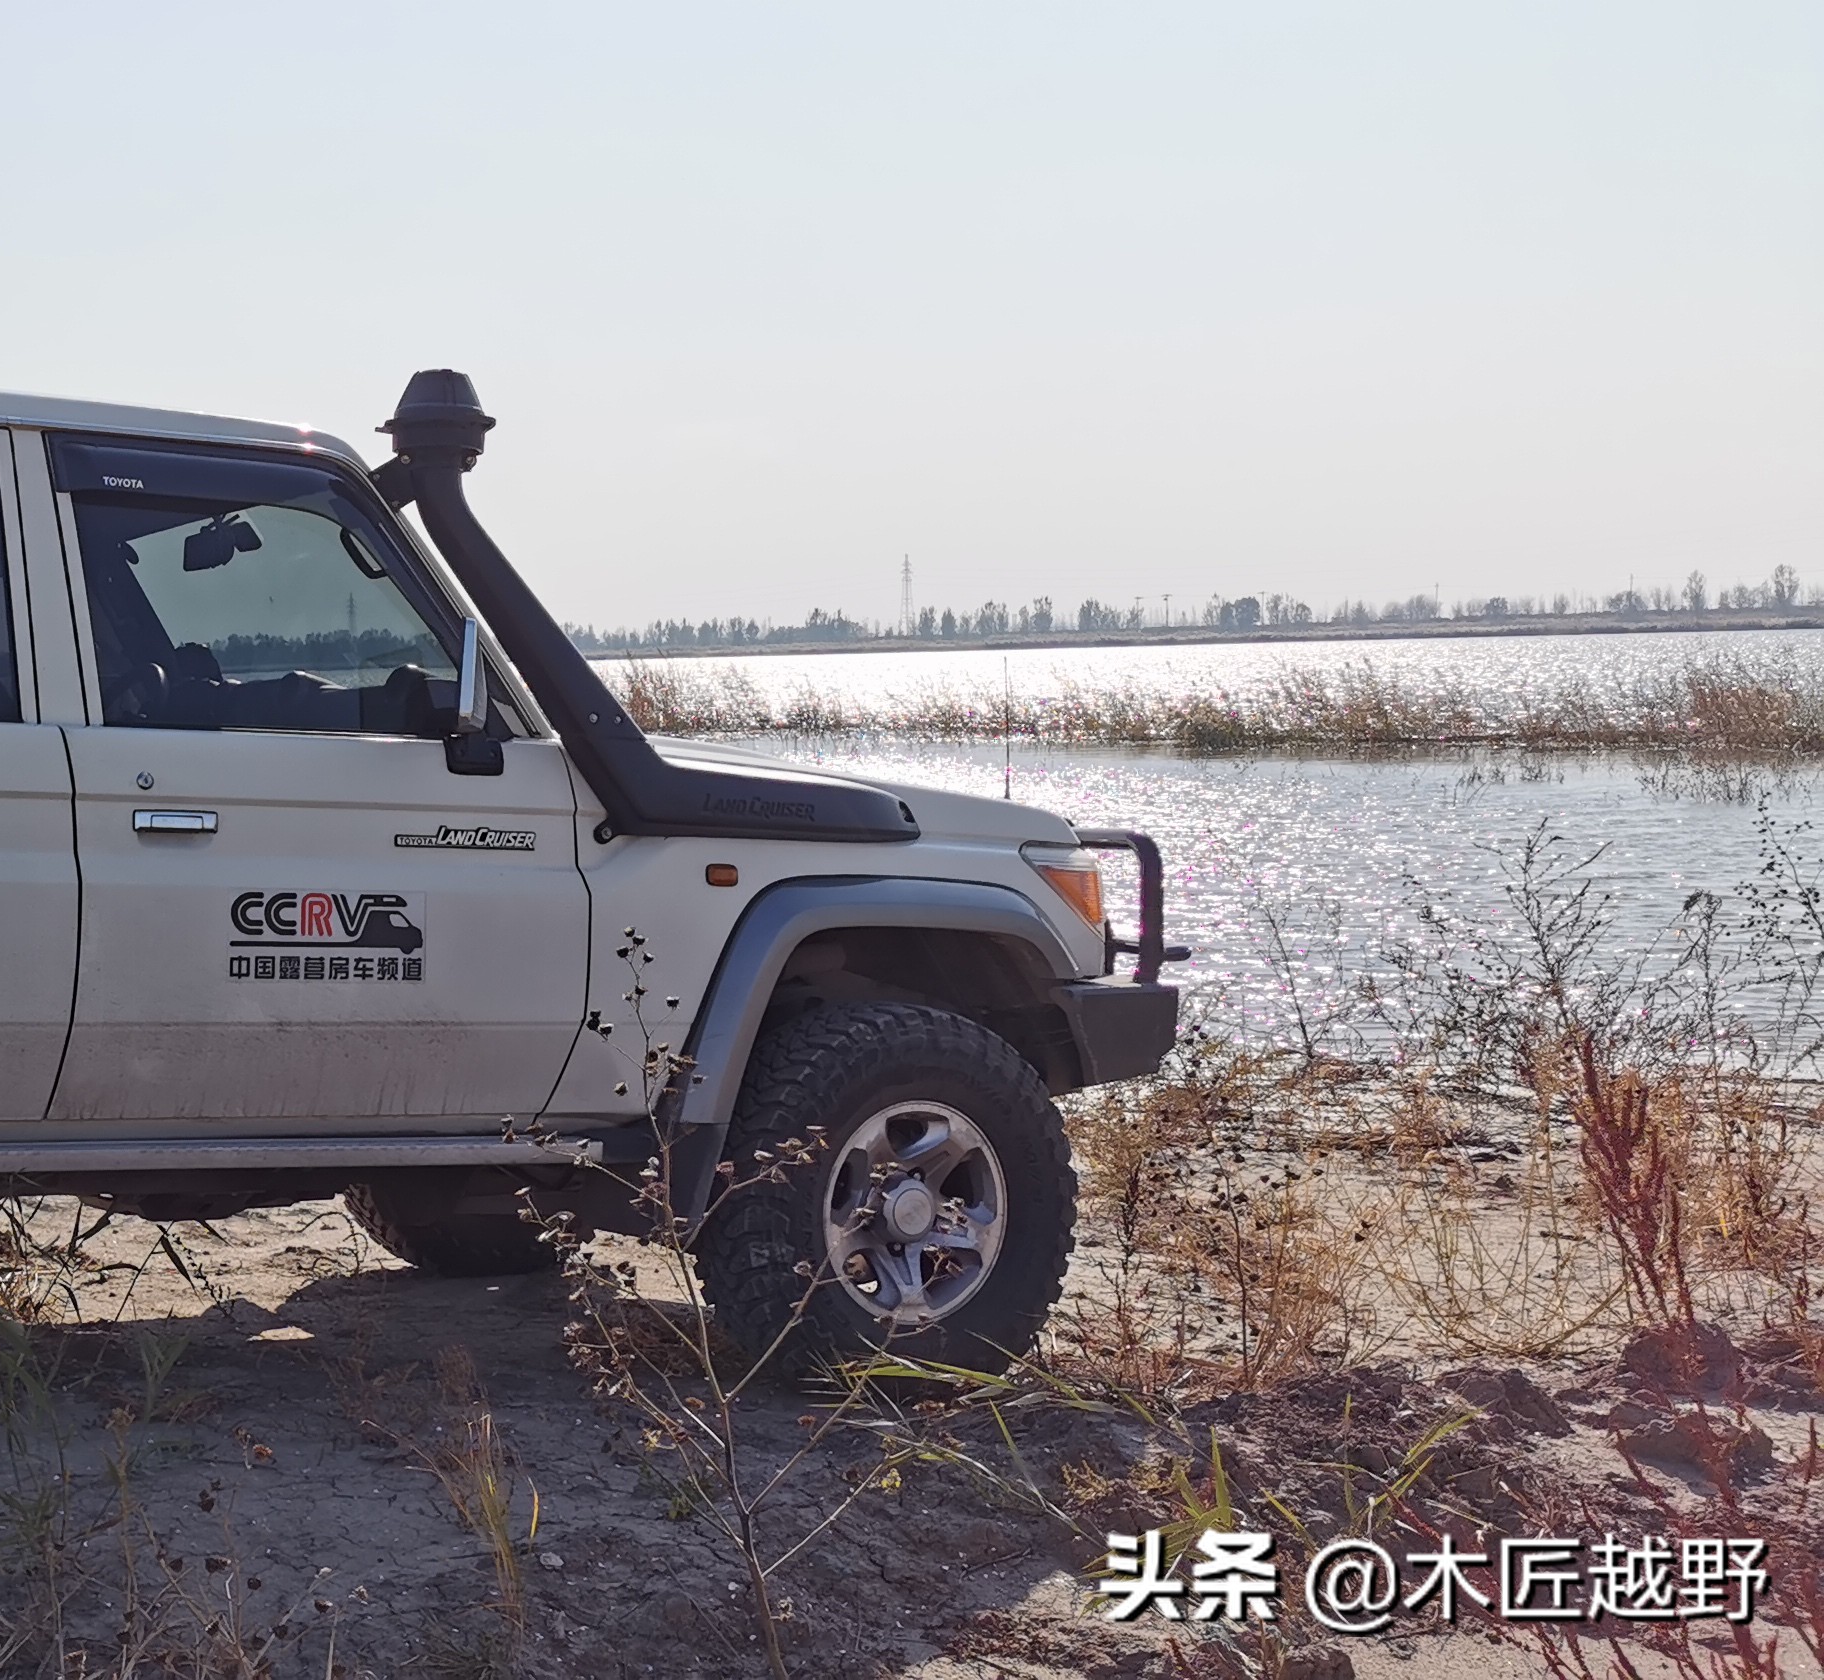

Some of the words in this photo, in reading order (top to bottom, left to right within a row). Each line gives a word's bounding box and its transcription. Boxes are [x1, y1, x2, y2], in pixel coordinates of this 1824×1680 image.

[102, 475, 145, 489] TOYOTA
[397, 836, 436, 846] TOYOTA
[230, 891, 374, 938] CCRV
[229, 954, 423, 982] 中国露营房车频道
